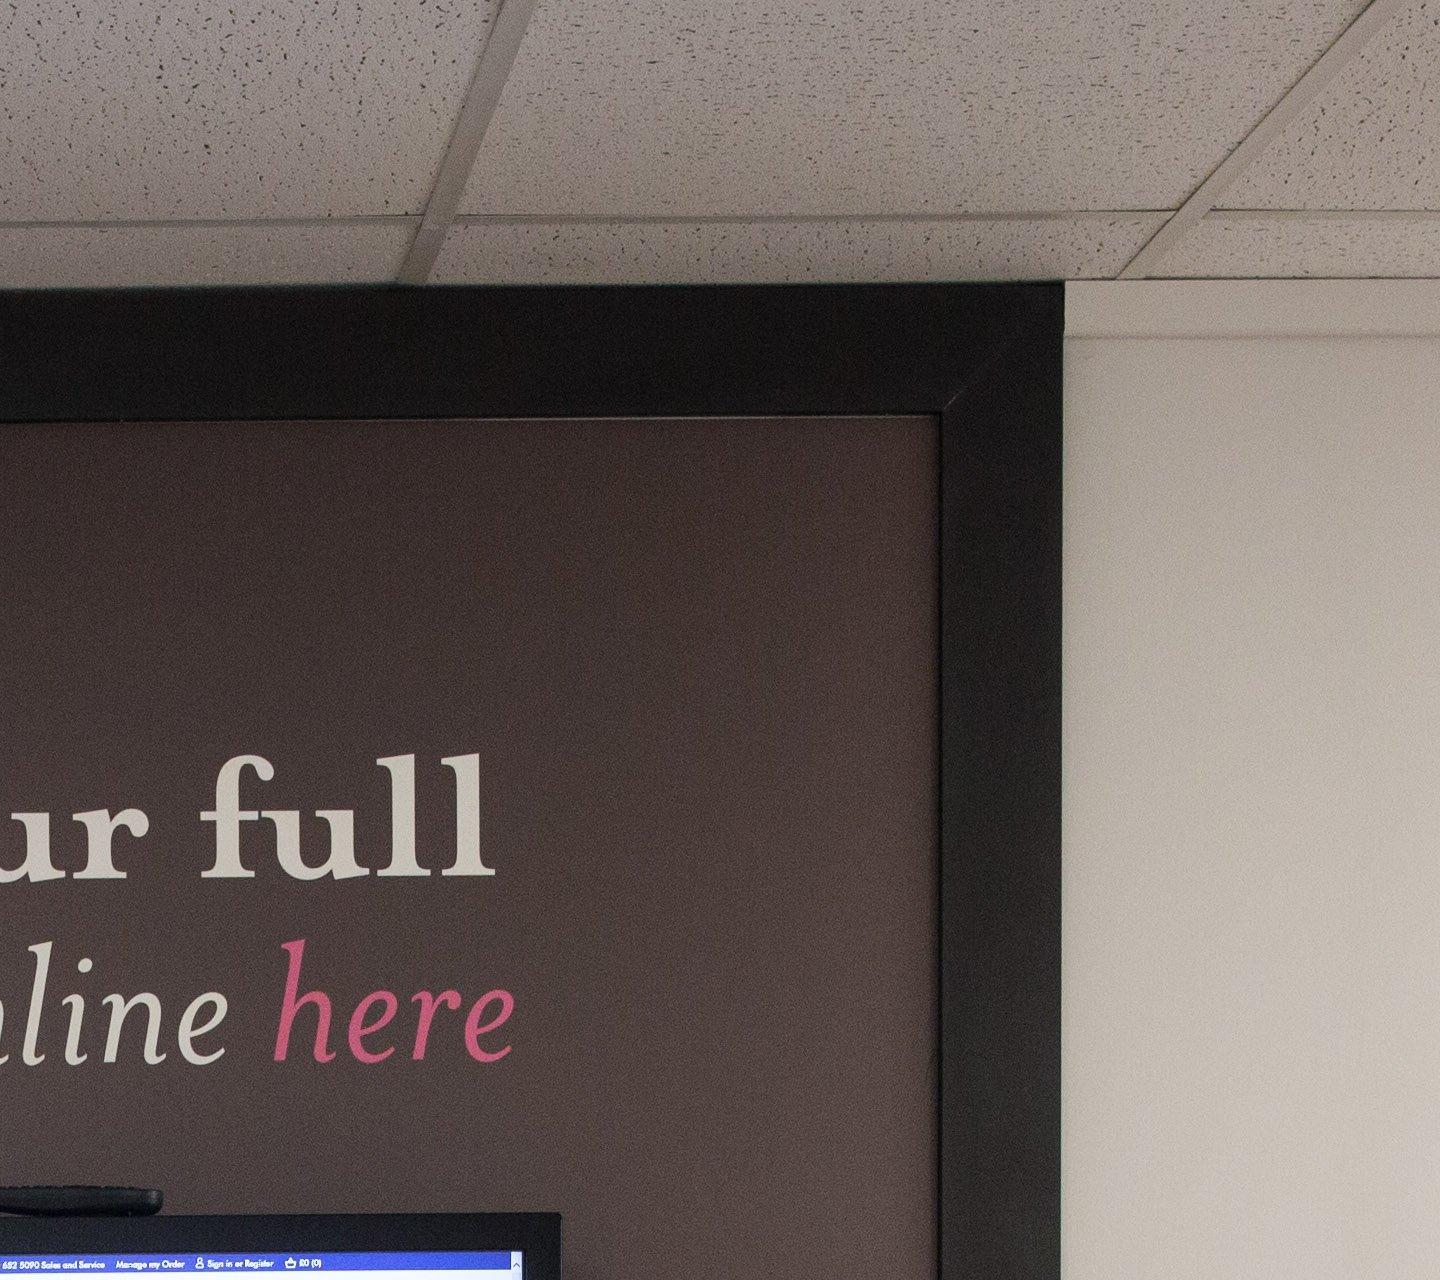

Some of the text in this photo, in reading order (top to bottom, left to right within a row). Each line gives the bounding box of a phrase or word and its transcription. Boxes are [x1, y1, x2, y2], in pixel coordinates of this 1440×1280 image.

[198, 752, 497, 881] full
[271, 936, 516, 1065] here
[41, 1260, 61, 1270] Sales
[62, 1260, 77, 1270] and
[78, 1260, 105, 1270] Service
[115, 1260, 185, 1271] Manage my Order
[207, 1259, 274, 1270] Sign Register
